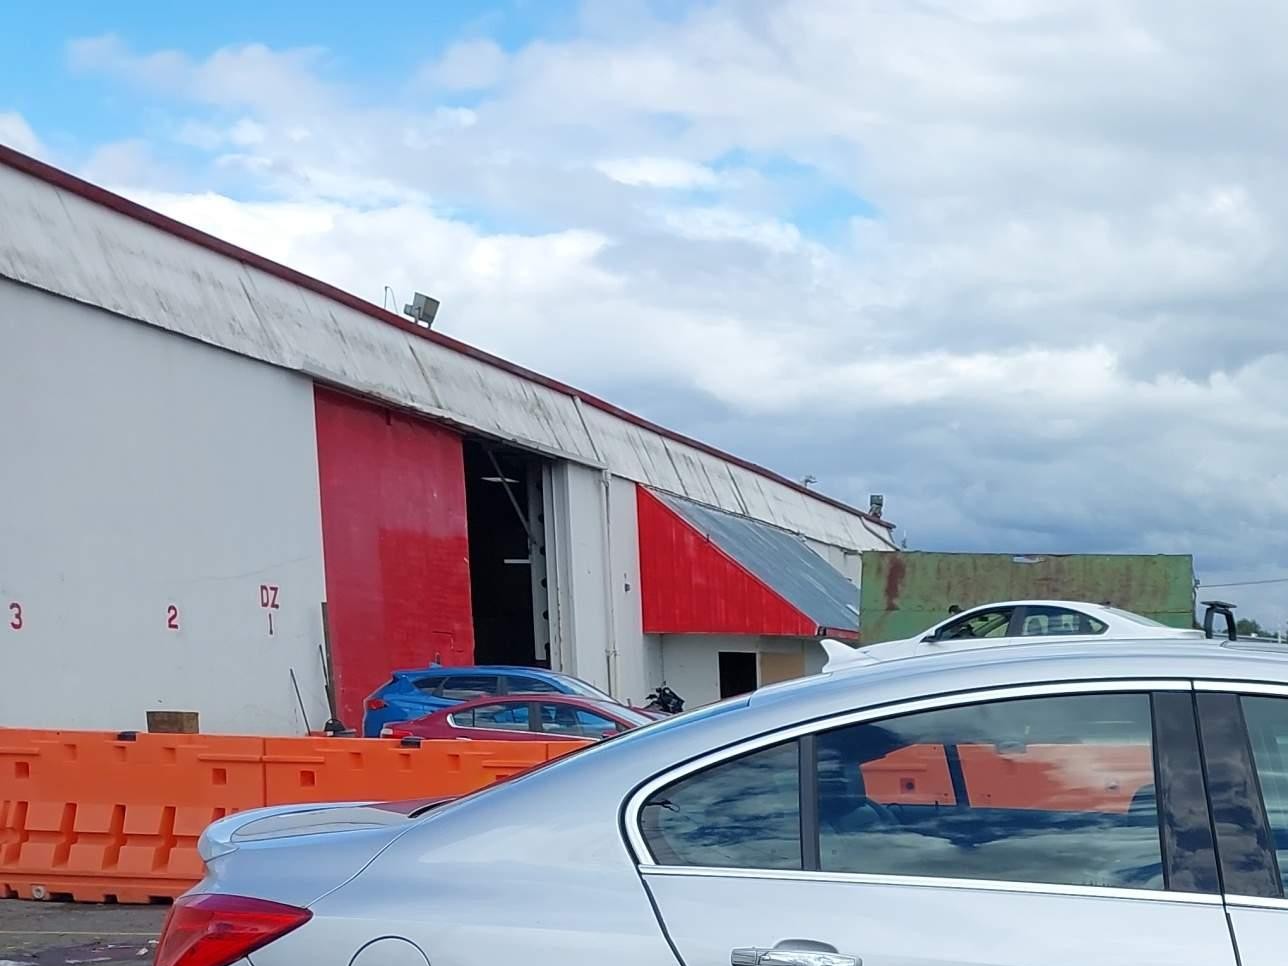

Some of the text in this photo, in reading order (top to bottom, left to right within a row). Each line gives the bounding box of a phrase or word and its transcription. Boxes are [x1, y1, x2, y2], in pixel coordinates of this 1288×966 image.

[260, 584, 280, 610] DZ
[9, 602, 23, 630] 3
[167, 605, 179, 630] 2
